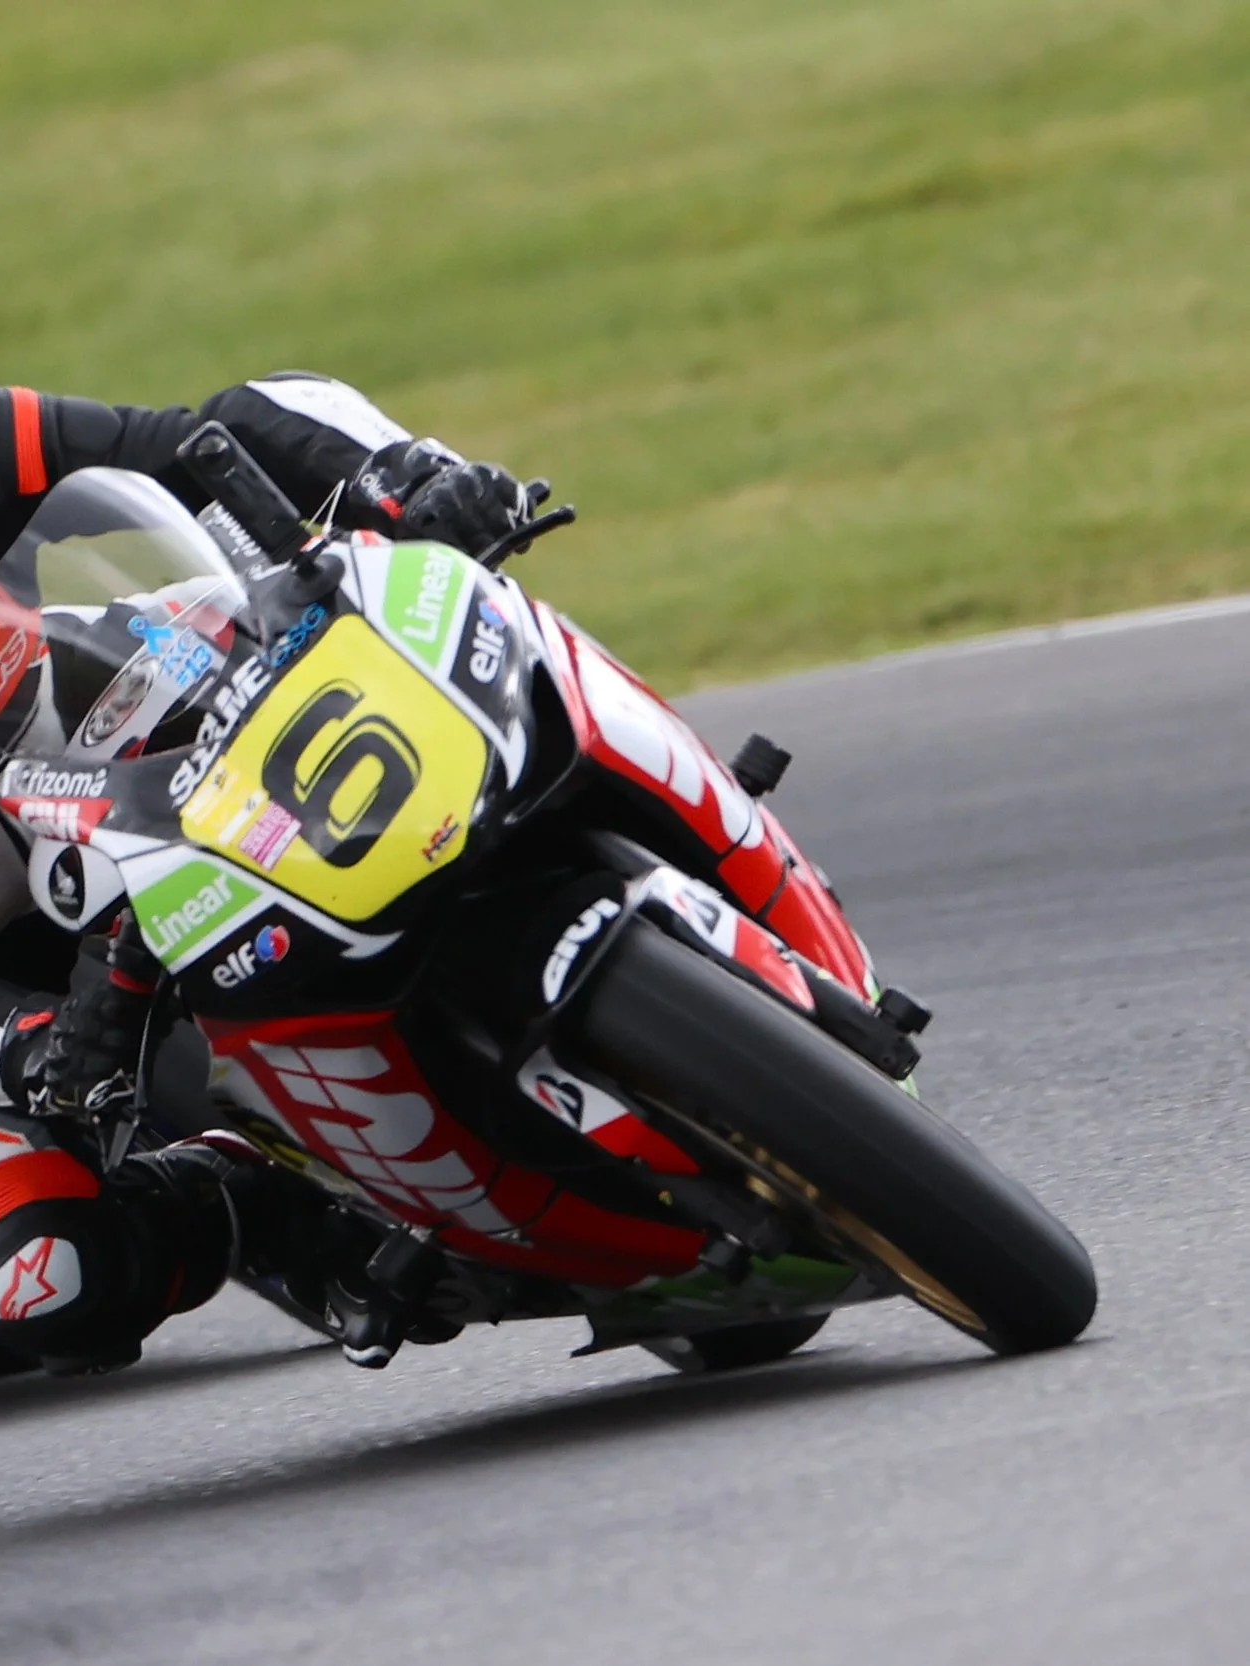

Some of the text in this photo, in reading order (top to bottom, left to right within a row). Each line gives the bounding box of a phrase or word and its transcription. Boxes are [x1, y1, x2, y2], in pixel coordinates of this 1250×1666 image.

[401, 548, 454, 643] Linear
[261, 678, 422, 870] 6
[211, 941, 257, 989] elf
